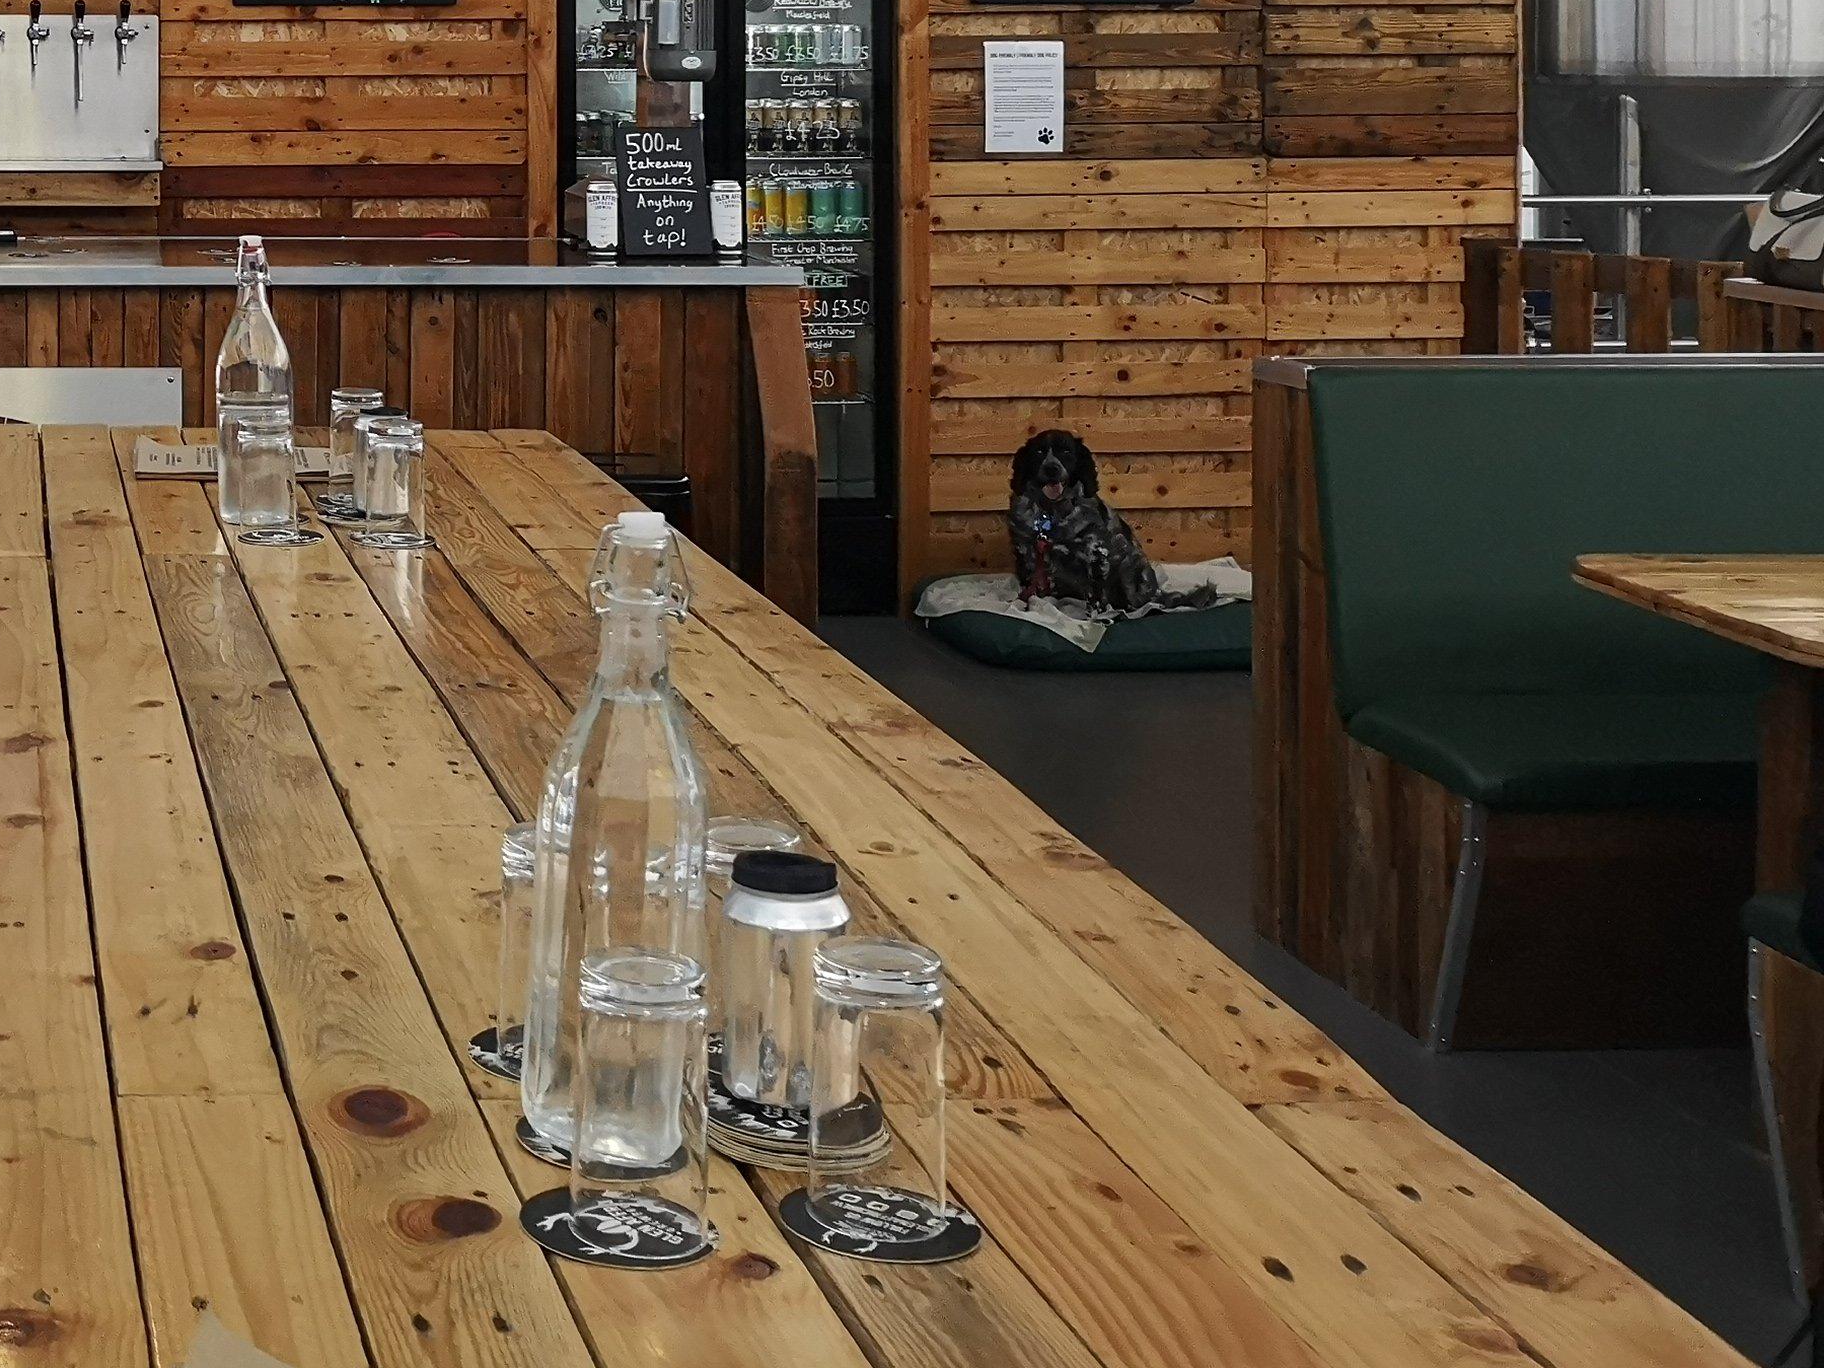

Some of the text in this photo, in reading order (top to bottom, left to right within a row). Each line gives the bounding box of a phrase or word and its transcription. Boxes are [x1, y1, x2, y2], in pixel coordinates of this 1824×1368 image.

[792, 88, 828, 96] London
[628, 156, 692, 174] takeaway
[627, 174, 694, 188] Crowlers
[636, 194, 694, 212] Anything
[656, 215, 674, 226] on
[643, 229, 687, 248] tap!
[813, 275, 845, 286] FREE
[799, 299, 870, 318] 3.50 £3.50
